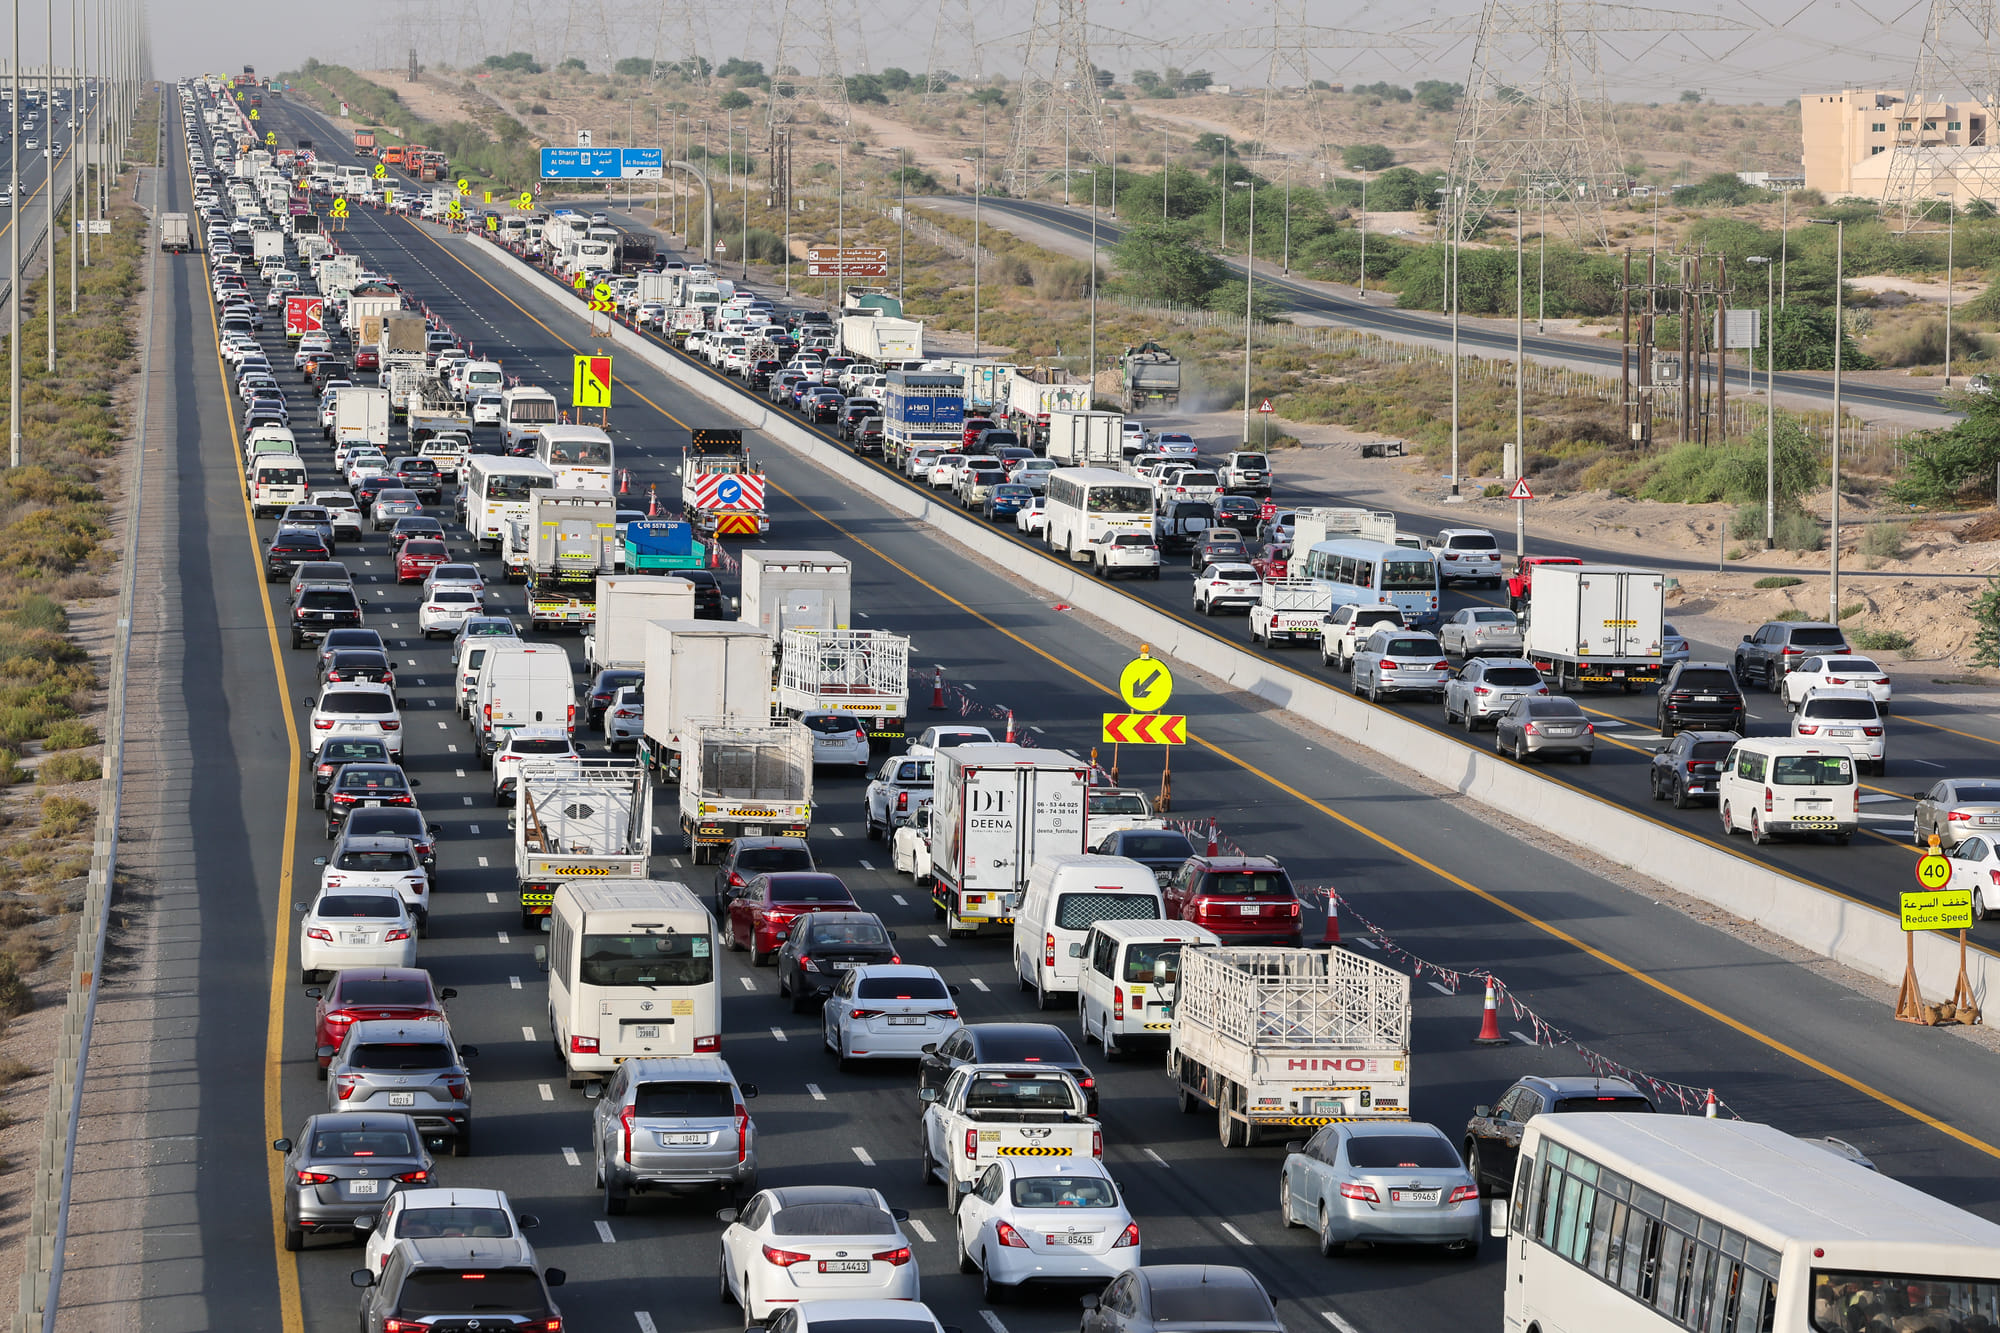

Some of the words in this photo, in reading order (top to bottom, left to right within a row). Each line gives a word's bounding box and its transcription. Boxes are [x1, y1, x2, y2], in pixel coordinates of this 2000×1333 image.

[971, 819, 1012, 829] DEENA
[1924, 864, 1945, 878] 40
[1904, 898, 1938, 910] السرعة
[1943, 898, 1969, 907] خفف
[1905, 915, 1938, 923] Reduce
[1941, 913, 1969, 923] Speed
[1288, 1059, 1366, 1071] HINO
[1413, 1192, 1436, 1200] 59463
[1068, 1236, 1093, 1244] 85415
[841, 1263, 866, 1271] 14413
